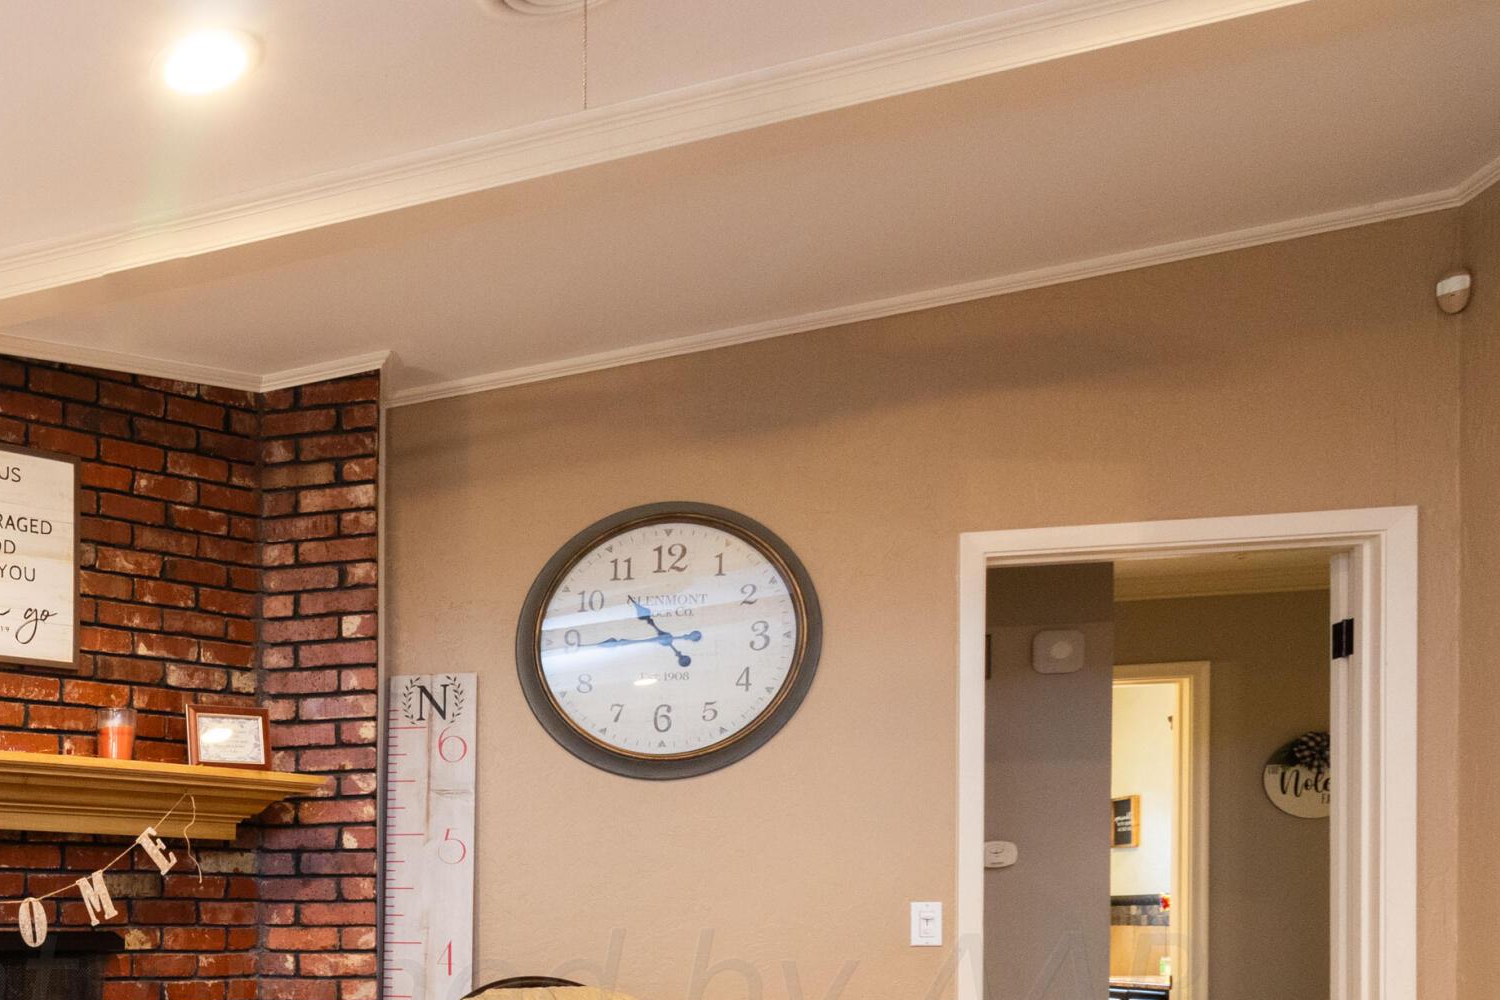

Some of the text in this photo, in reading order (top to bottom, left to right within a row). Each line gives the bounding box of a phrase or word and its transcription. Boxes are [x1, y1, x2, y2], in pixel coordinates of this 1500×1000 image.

[609, 557, 634, 581] 11
[652, 543, 688, 574] 12
[713, 552, 726, 576] 1
[577, 589, 604, 613] 10
[740, 583, 758, 606] 2
[14, 607, 59, 645] go
[749, 620, 770, 651] 3
[564, 629, 580, 651] 9
[576, 673, 592, 694] 8
[736, 666, 752, 691] 4
[416, 684, 449, 721] N
[610, 703, 624, 723] 7
[702, 701, 718, 721] 5
[653, 704, 672, 733] 6
[438, 726, 467, 763] 6
[438, 828, 467, 865] 5
[437, 940, 453, 976] 4
